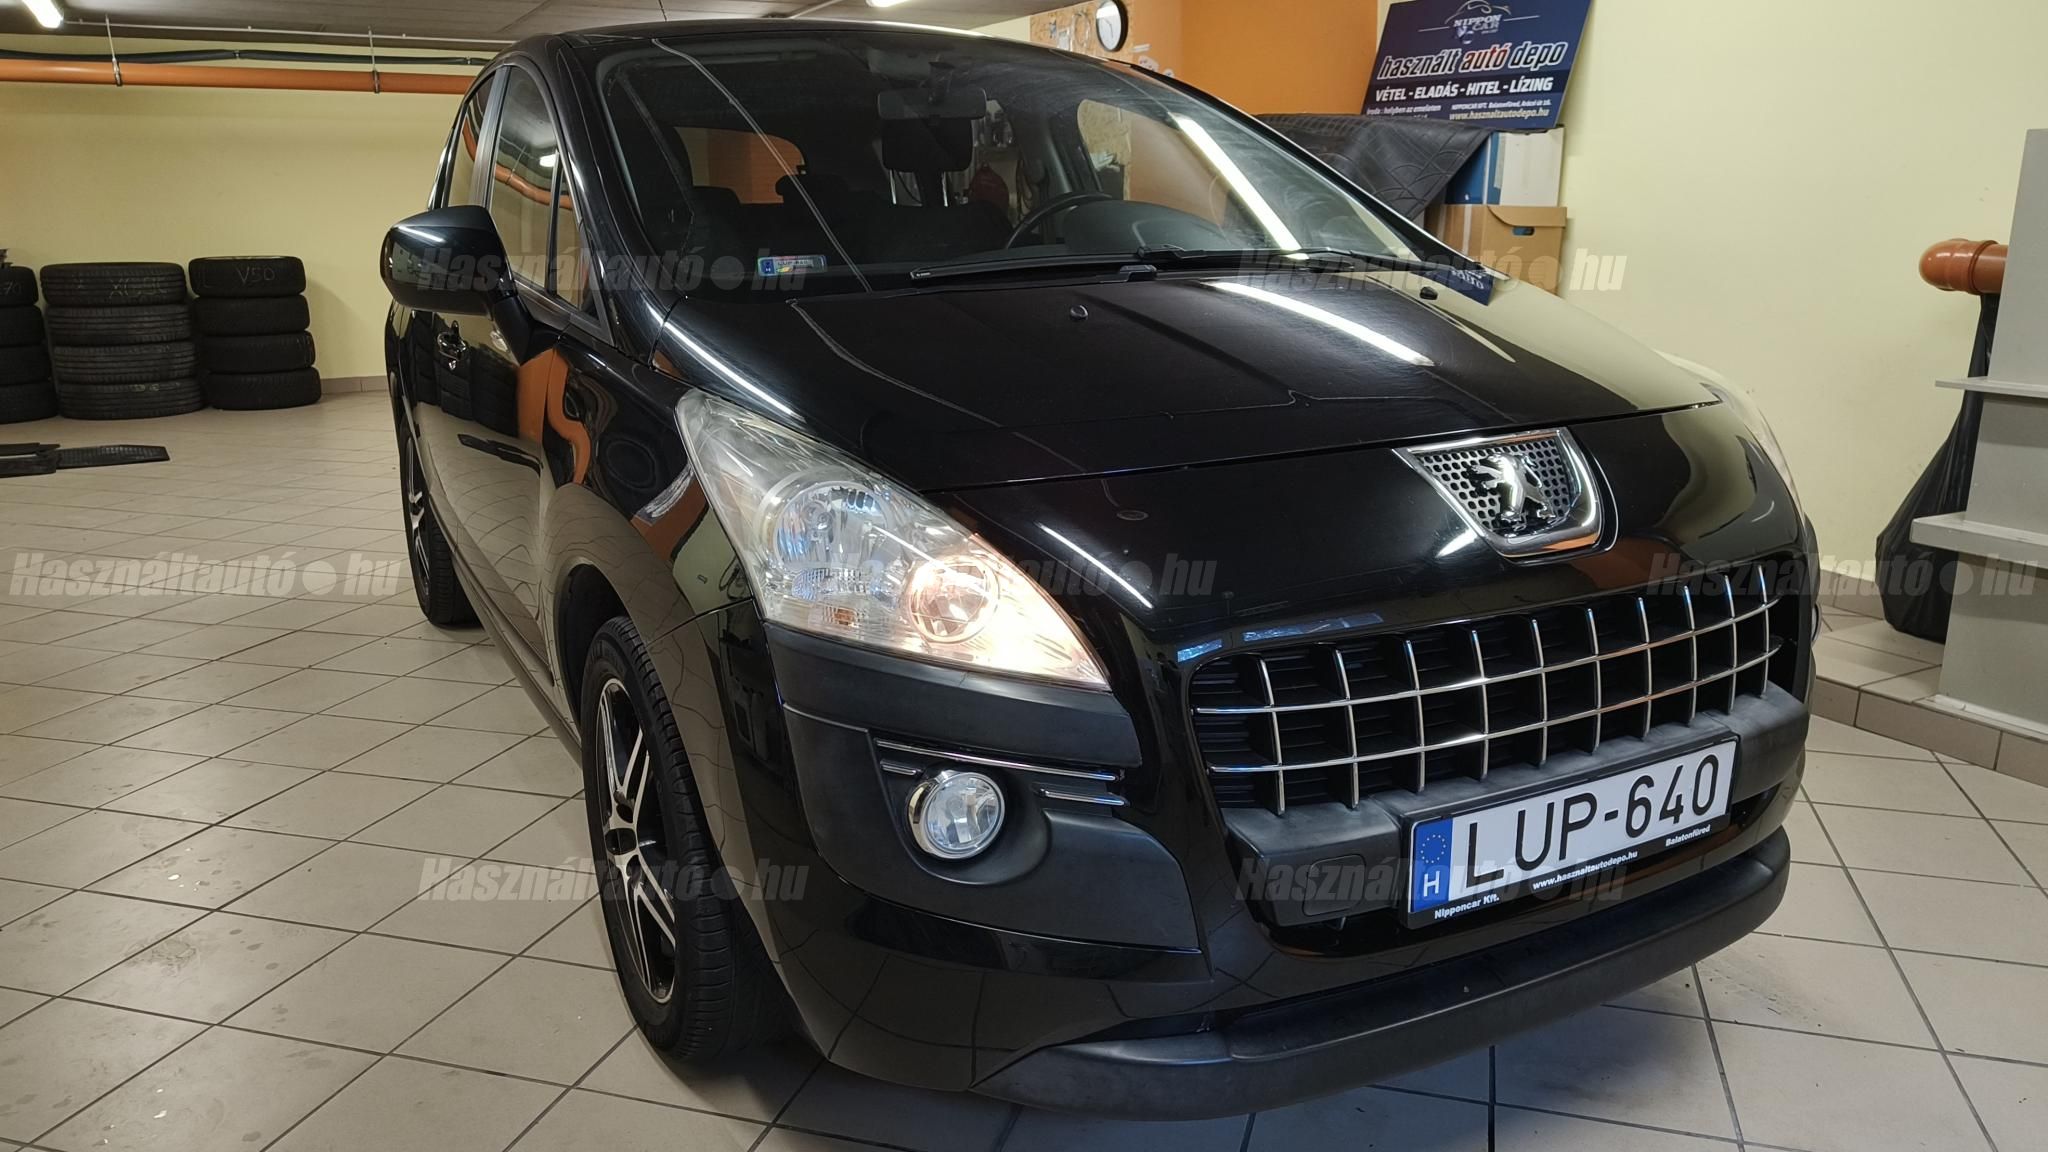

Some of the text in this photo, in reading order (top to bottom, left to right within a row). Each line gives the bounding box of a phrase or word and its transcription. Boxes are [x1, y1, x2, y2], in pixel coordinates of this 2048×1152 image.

[1453, 14, 1502, 27] NIPPON
[1472, 22, 1500, 31] CAR
[1377, 41, 1568, 80] használt autó depo
[1376, 86, 1407, 102] VÉTEL
[1414, 82, 1460, 99] ELADÁS
[1466, 81, 1501, 96] HITEL
[1509, 76, 1554, 93] LÍZING
[236, 265, 275, 284] V50
[1466, 753, 1719, 889] LUP-640
[1665, 824, 1711, 847] Balatonfüred
[1532, 850, 1638, 891] www.hasznaltautodepo.hu
[1423, 871, 1440, 897] H
[1434, 894, 1500, 919] Nipponcar Kft.
